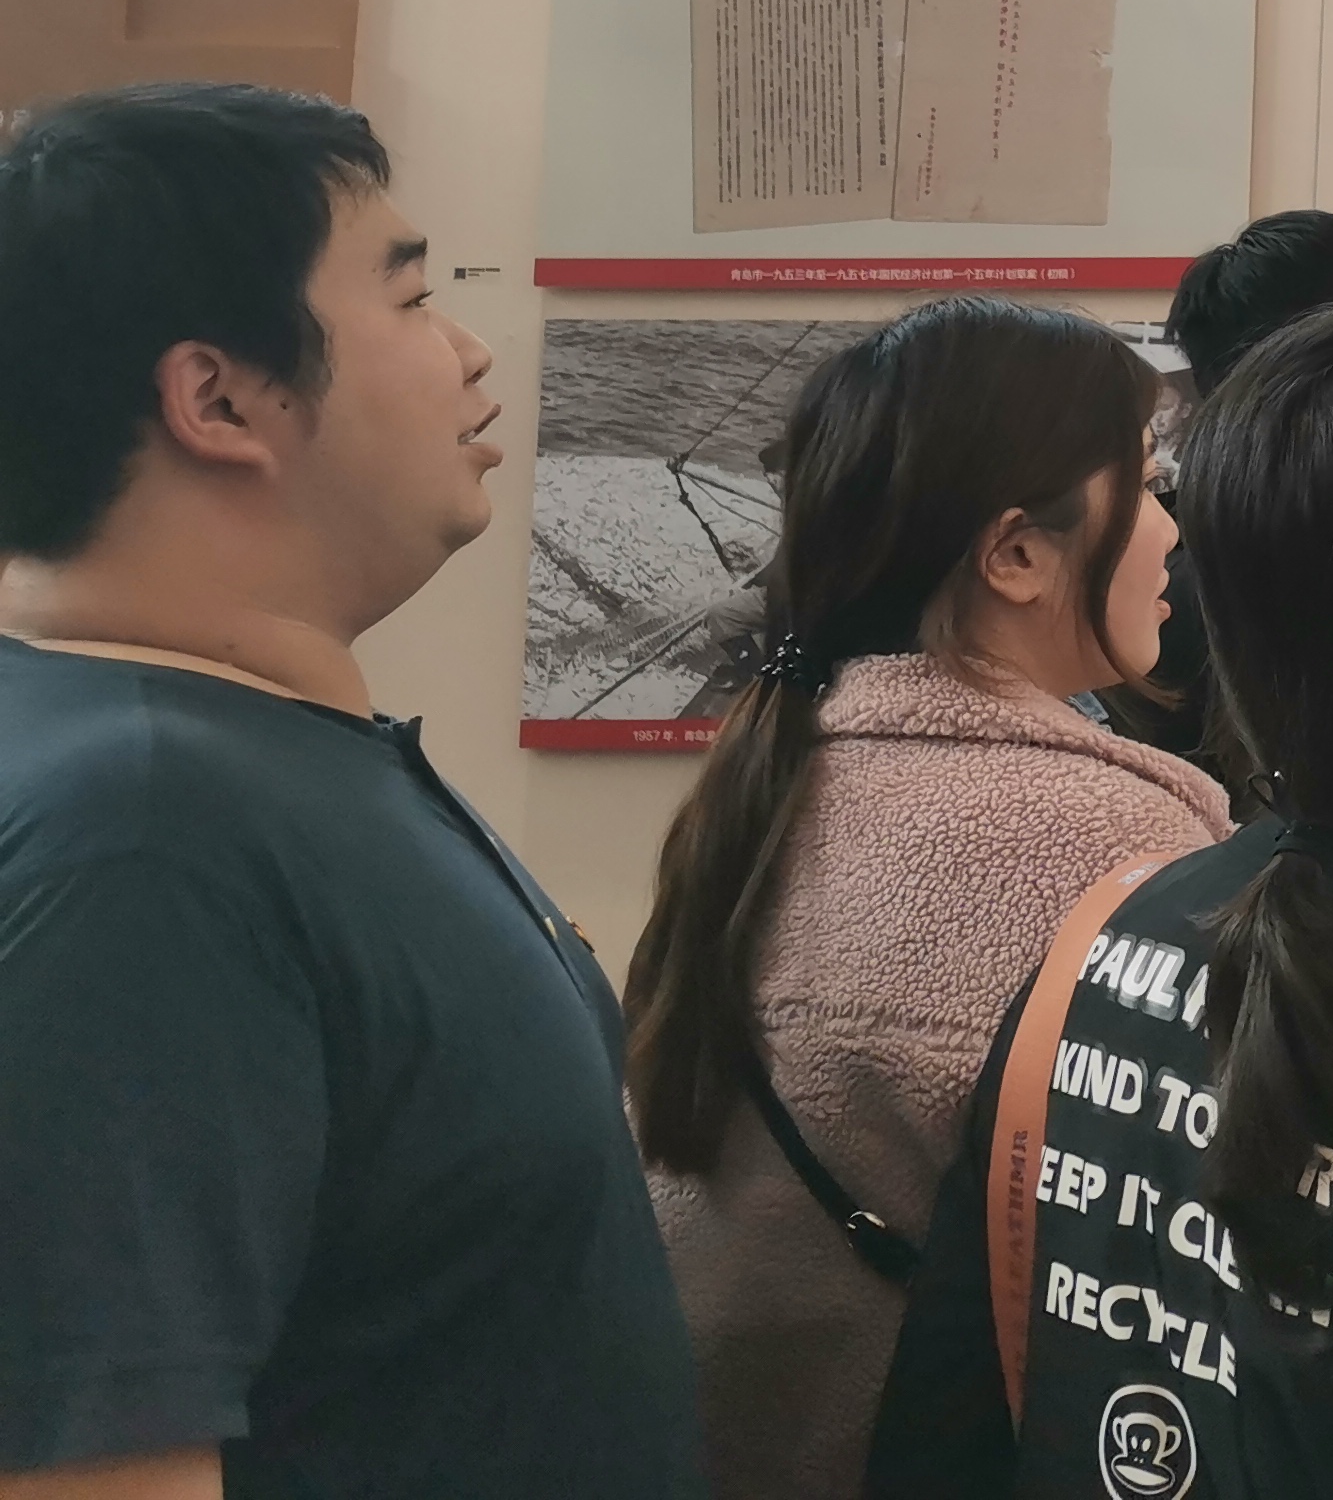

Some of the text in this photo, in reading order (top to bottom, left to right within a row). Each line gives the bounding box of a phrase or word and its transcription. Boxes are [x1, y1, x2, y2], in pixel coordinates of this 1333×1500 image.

[1077, 934, 1178, 1008] PAUL
[1053, 1039, 1142, 1114] KIND
[1157, 1075, 1219, 1149] TO
[1036, 1145, 1107, 1215] EEP
[1117, 1173, 1161, 1236] IT
[1045, 1261, 1237, 1397] RECYCLE
